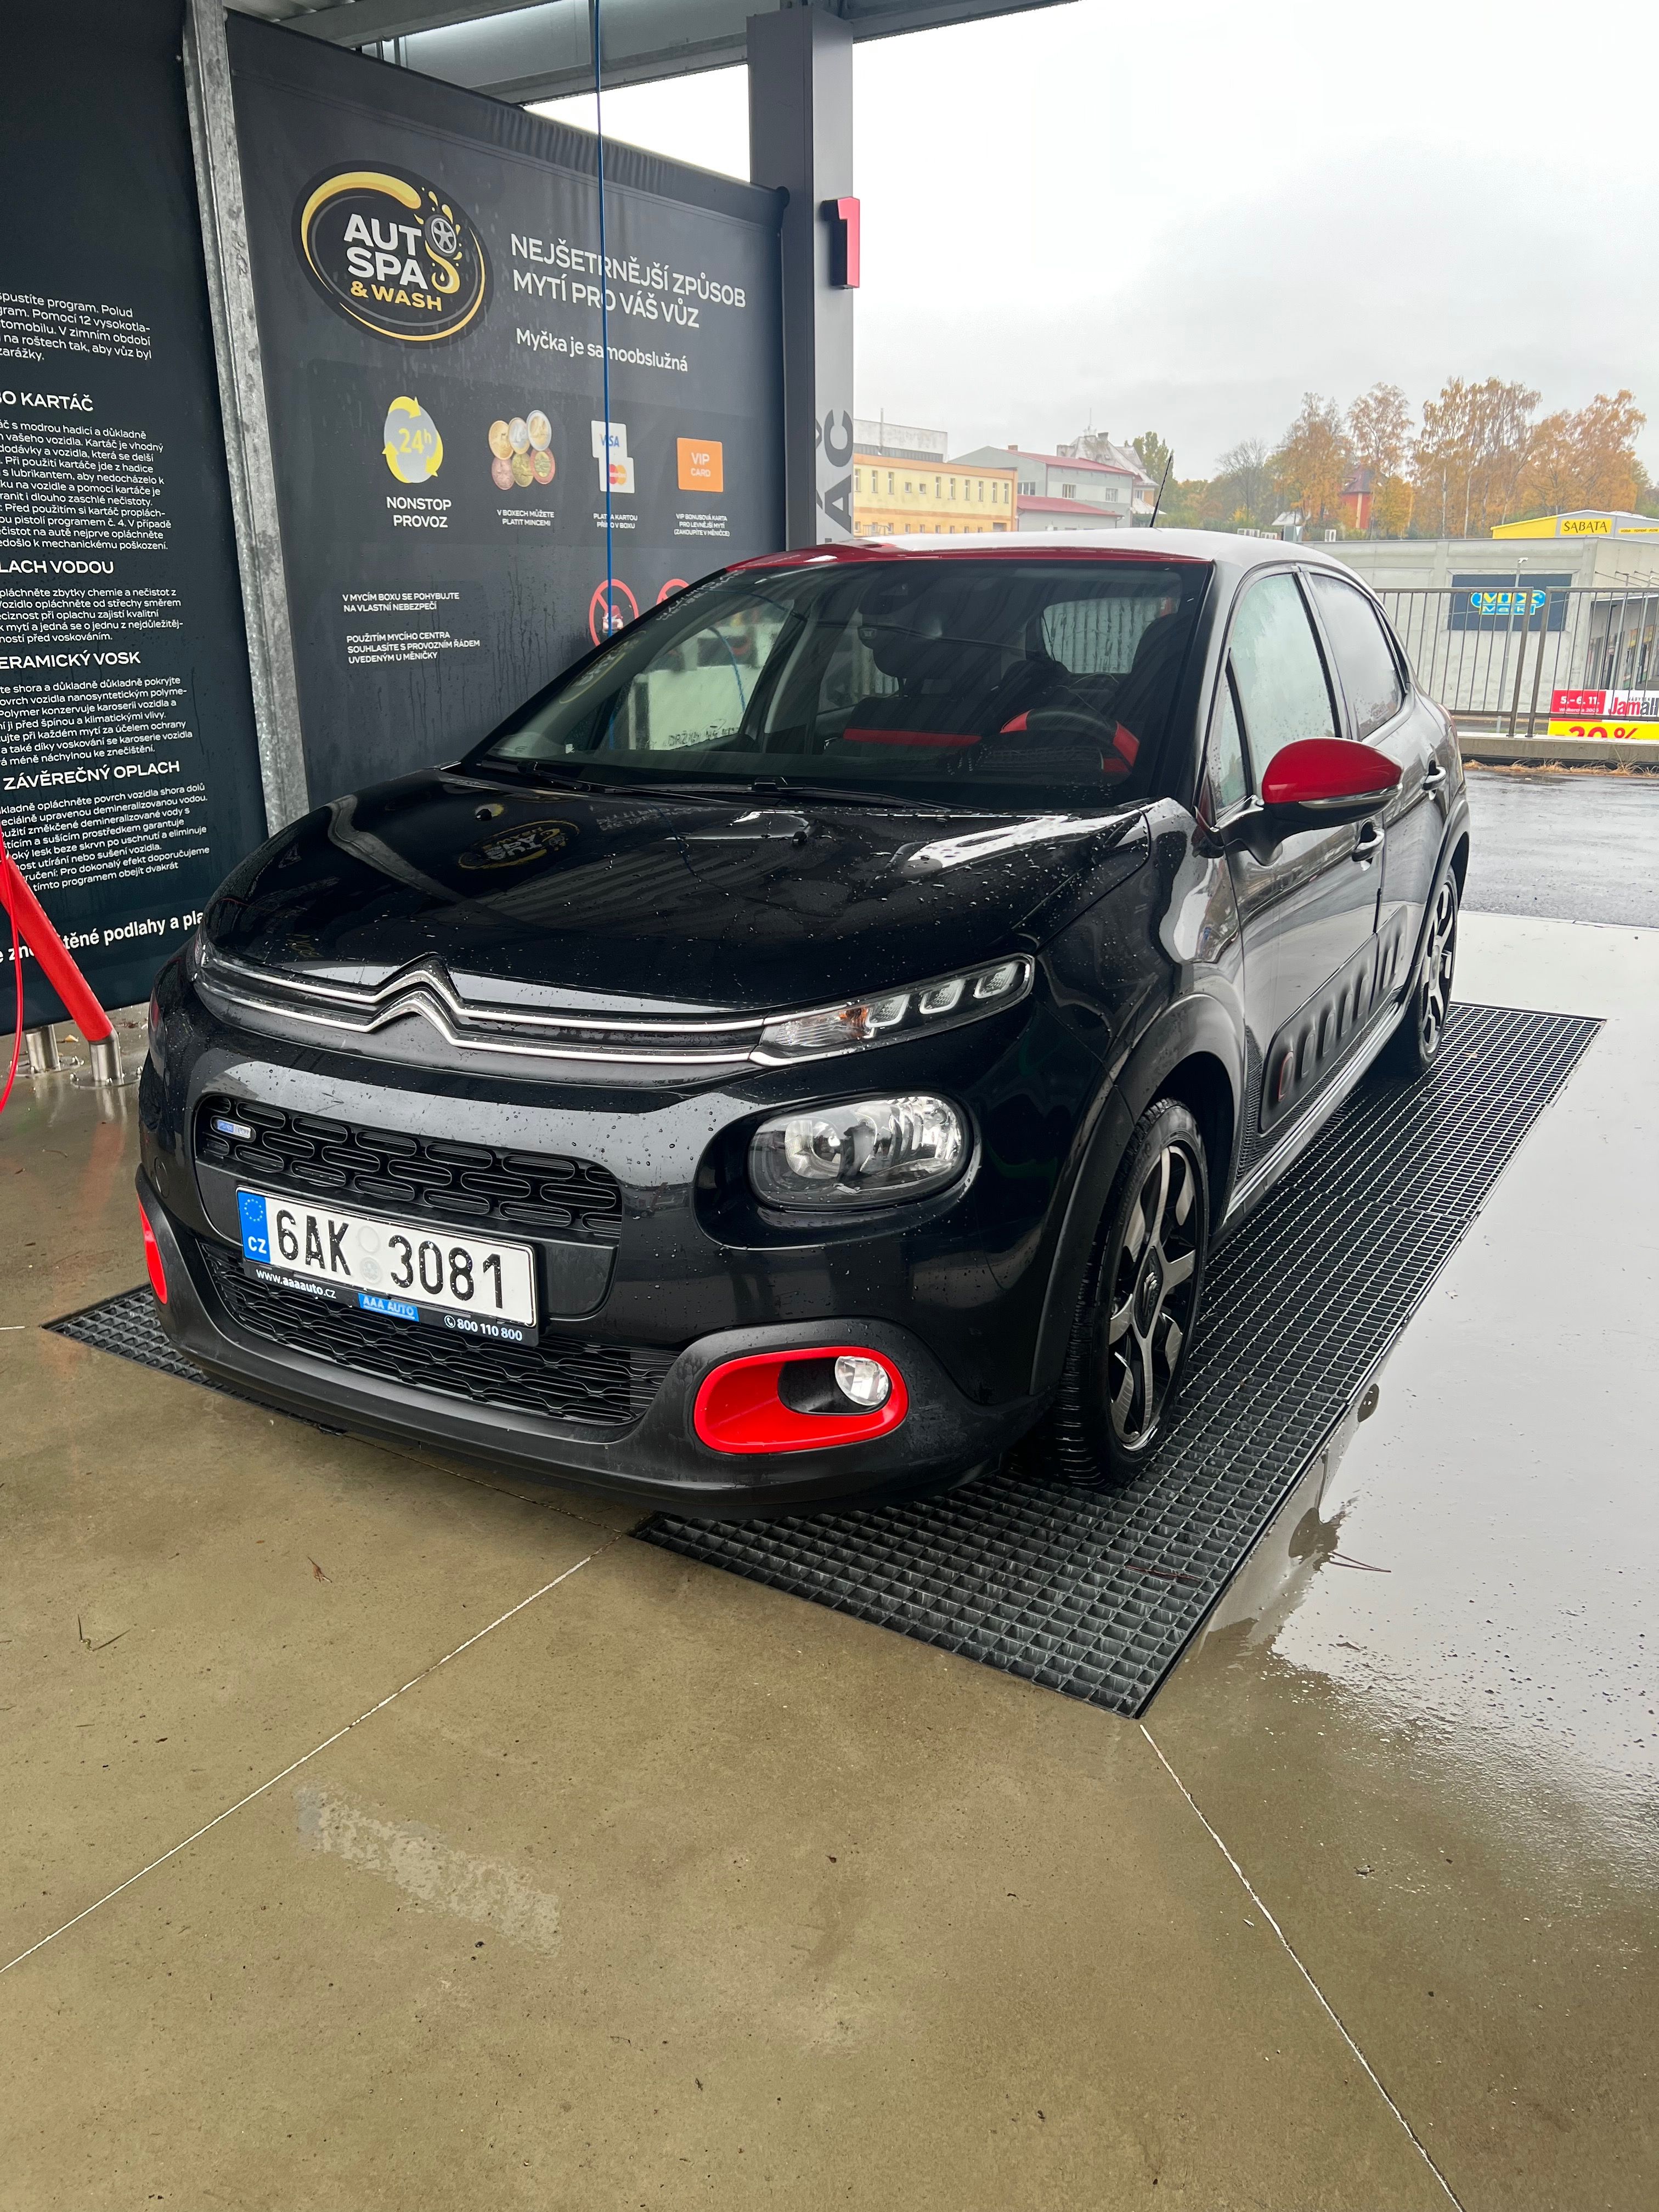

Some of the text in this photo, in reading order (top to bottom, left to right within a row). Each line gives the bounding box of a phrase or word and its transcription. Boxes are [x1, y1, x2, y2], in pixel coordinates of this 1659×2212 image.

[346, 246, 428, 290] SPA
[351, 281, 442, 312] & WASH
[673, 272, 746, 307] ZPŮSOB
[514, 269, 699, 328] MYTÍ PRO VÁŠ VŮZ
[47, 300, 99, 313] program.
[101, 305, 133, 317] Polud
[32, 309, 76, 323] Pomocí
[79, 315, 91, 325] 12
[93, 319, 150, 332] vysokotla-
[0, 319, 150, 346] tomobilu. V zimním období
[517, 328, 688, 372] Myčka je samoobslužná
[21, 392, 93, 411] KARTÁČ
[600, 434, 620, 448] VSA
[53, 449, 89, 458] vozidla,
[92, 450, 116, 459] která
[132, 453, 154, 461] delší
[691, 452, 710, 466] VIP
[11, 469, 75, 480] lubrikantem,
[77, 472, 94, 482] aby
[97, 474, 156, 484] nedocházelo
[691, 468, 712, 477] CARD
[31, 493, 66, 502] dlouho
[68, 495, 105, 504] zaschlé
[108, 496, 153, 507] nečistoty.
[387, 497, 451, 510] NONSTOP
[529, 509, 554, 517] MŮŽETE
[393, 515, 448, 527] PROVOZ
[1564, 521, 1607, 533] ŠABATA
[0, 527, 31, 535] čistot
[49, 528, 71, 537] autě
[74, 529, 109, 539] nejprve
[112, 530, 163, 539] opláchněte
[33, 539, 40, 547] k
[42, 540, 117, 549] mechanickému
[120, 541, 168, 550] poškození.
[50, 561, 114, 573] VODOU
[350, 592, 377, 601] MYCÍM
[414, 592, 460, 601] POHYBUJTE
[357, 602, 391, 611] VLASTNÍ
[393, 601, 437, 610] NEBEZPEČÍ
[0, 609, 159, 621] ciznost při oplachu zajistí kvalitní
[347, 633, 386, 642] POUŽITÍM
[387, 631, 418, 641] MYCÍHO
[347, 641, 399, 653] SOUHLASÍTE
[407, 640, 452, 651] PROVOZNÍM
[454, 639, 480, 647] ŘÁDEM
[93, 652, 140, 665] VOSK
[348, 653, 394, 663] UVEDENÝM
[403, 651, 437, 661] MĚNIČKY
[30, 695, 65, 703] vozidla
[68, 690, 148, 701] nanosyntetickým
[150, 689, 187, 698] polyme-
[3, 761, 179, 790] ZÁVĚREČNÝ OPLACH
[40, 809, 91, 822] upravenou
[93, 799, 177, 815] demineralizovanou
[24, 870, 58, 883] ručení:
[79, 859, 121, 872] dokonalý
[123, 856, 146, 866] efekt
[148, 848, 209, 862] doporučujeme
[62, 872, 116, 888] programem
[119, 867, 144, 877] obejít
[146, 861, 178, 873] dvakrát
[104, 919, 165, 946] podlahy
[170, 917, 179, 929] a
[248, 1209, 503, 1309] CZ 6AK 3081
[256, 1269, 337, 1299] www.aaaauto.cz
[363, 1296, 415, 1317] AAA AUTO
[457, 1319, 523, 1341] 800 110 800
